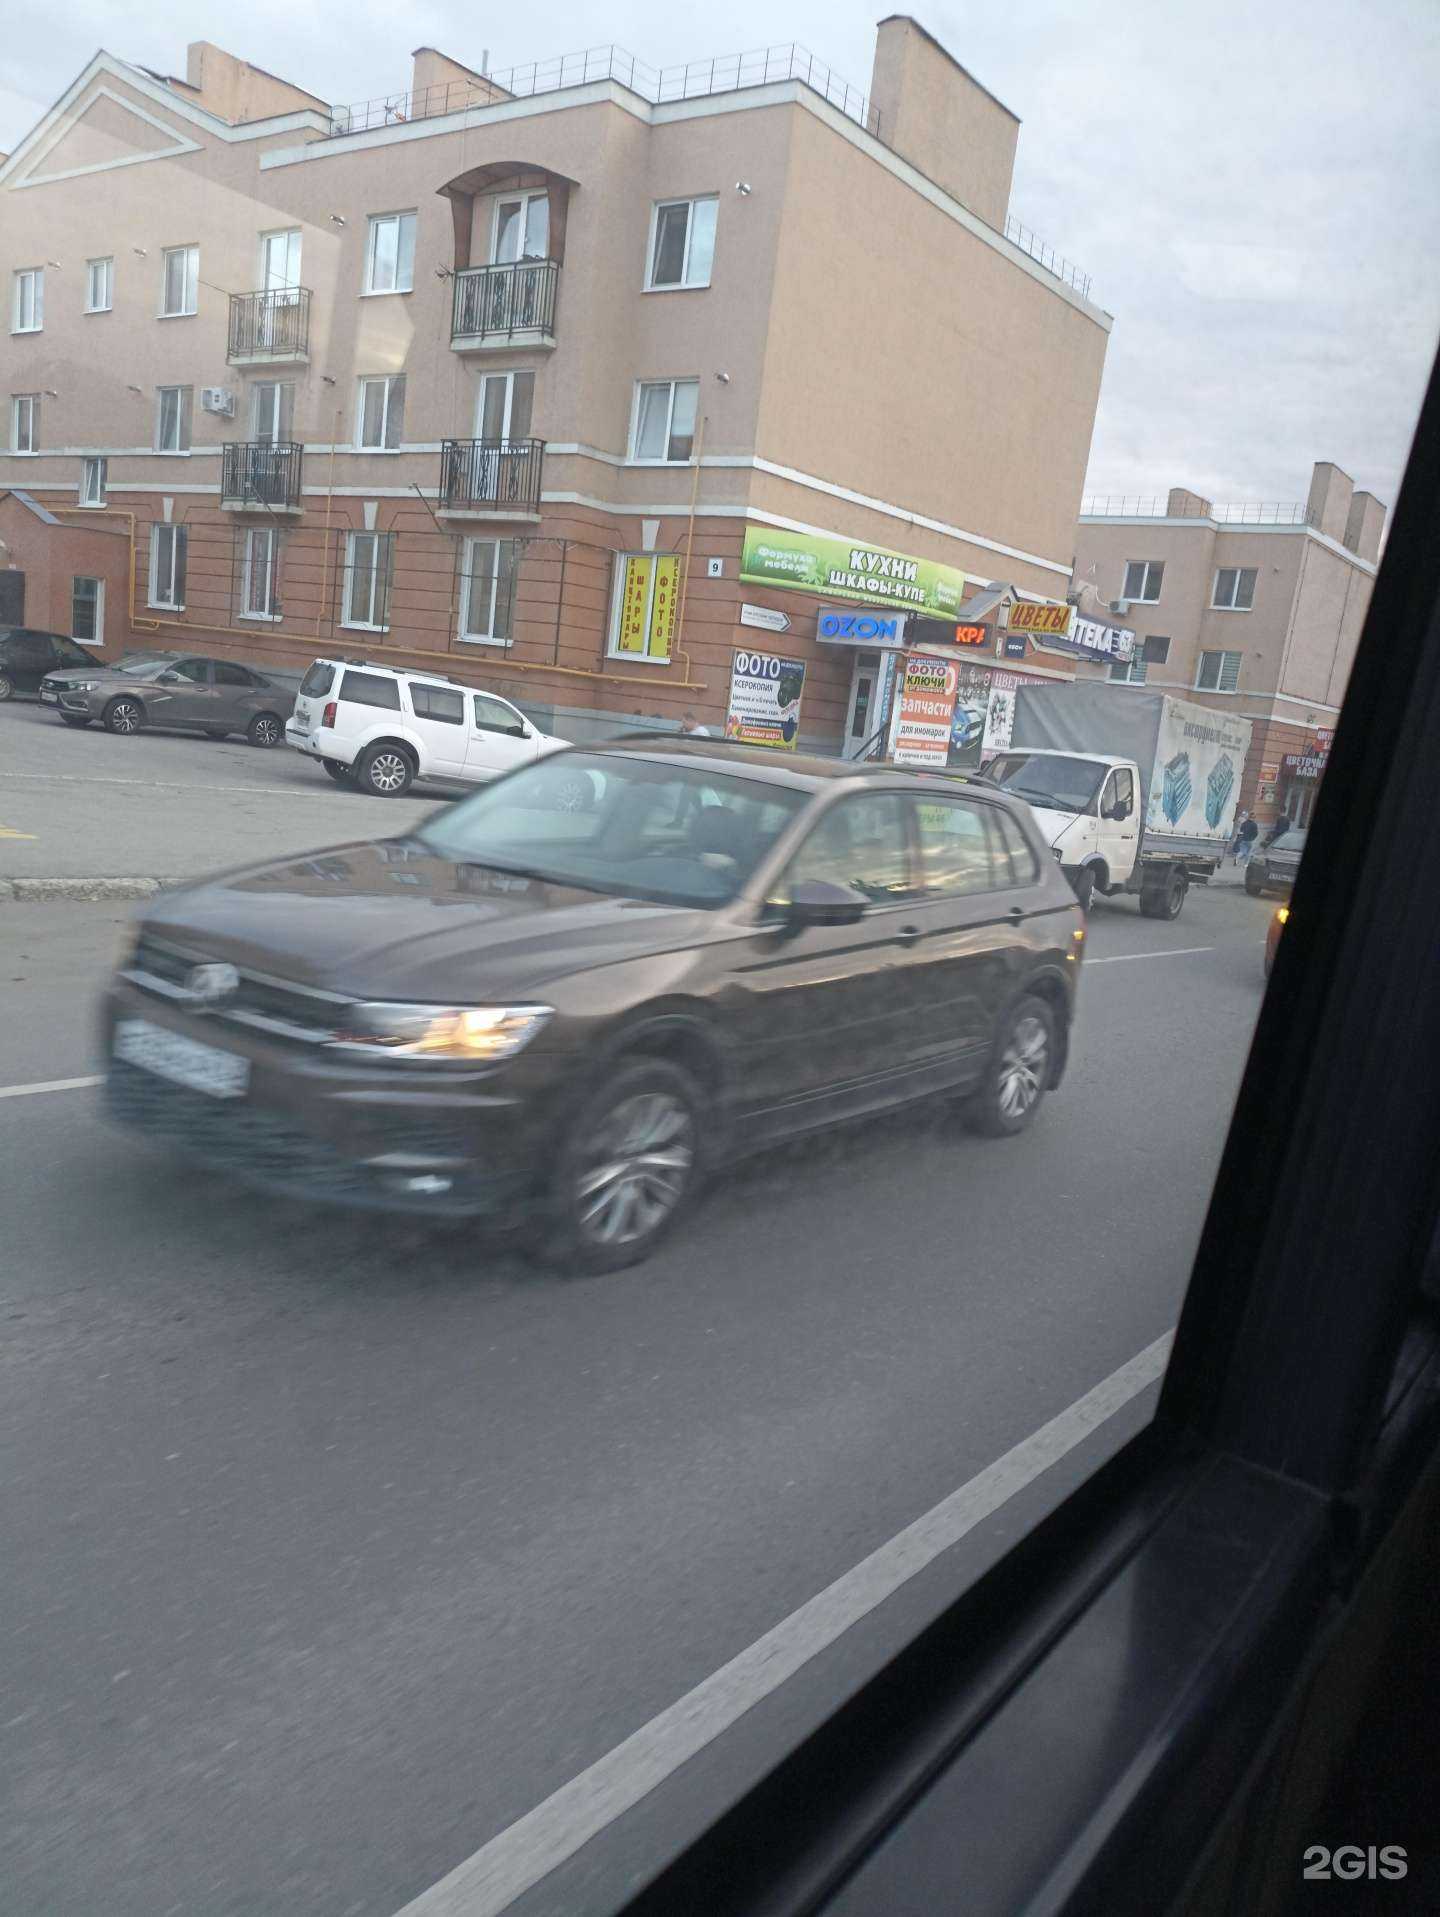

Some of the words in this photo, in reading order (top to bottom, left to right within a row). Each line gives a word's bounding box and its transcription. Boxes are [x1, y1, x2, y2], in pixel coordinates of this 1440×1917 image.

[711, 563, 719, 574] 9
[850, 549, 918, 582] КУХНИ
[829, 570, 926, 602] ШКАФЫ-КУПЕ
[631, 575, 645, 634] ШАРЫ
[656, 576, 668, 637] ФОТО
[1011, 604, 1070, 629] ЦВЕТЫ
[821, 614, 897, 640] OZON
[736, 652, 781, 679] ФОТО
[908, 664, 946, 676] ФОТО
[734, 680, 773, 693] КСЕРОКОПИЯ
[907, 675, 946, 688] КЛЮЧИ
[900, 725, 913, 735] для
[914, 726, 946, 739] иномарок
[1296, 766, 1318, 777] БАЗА
